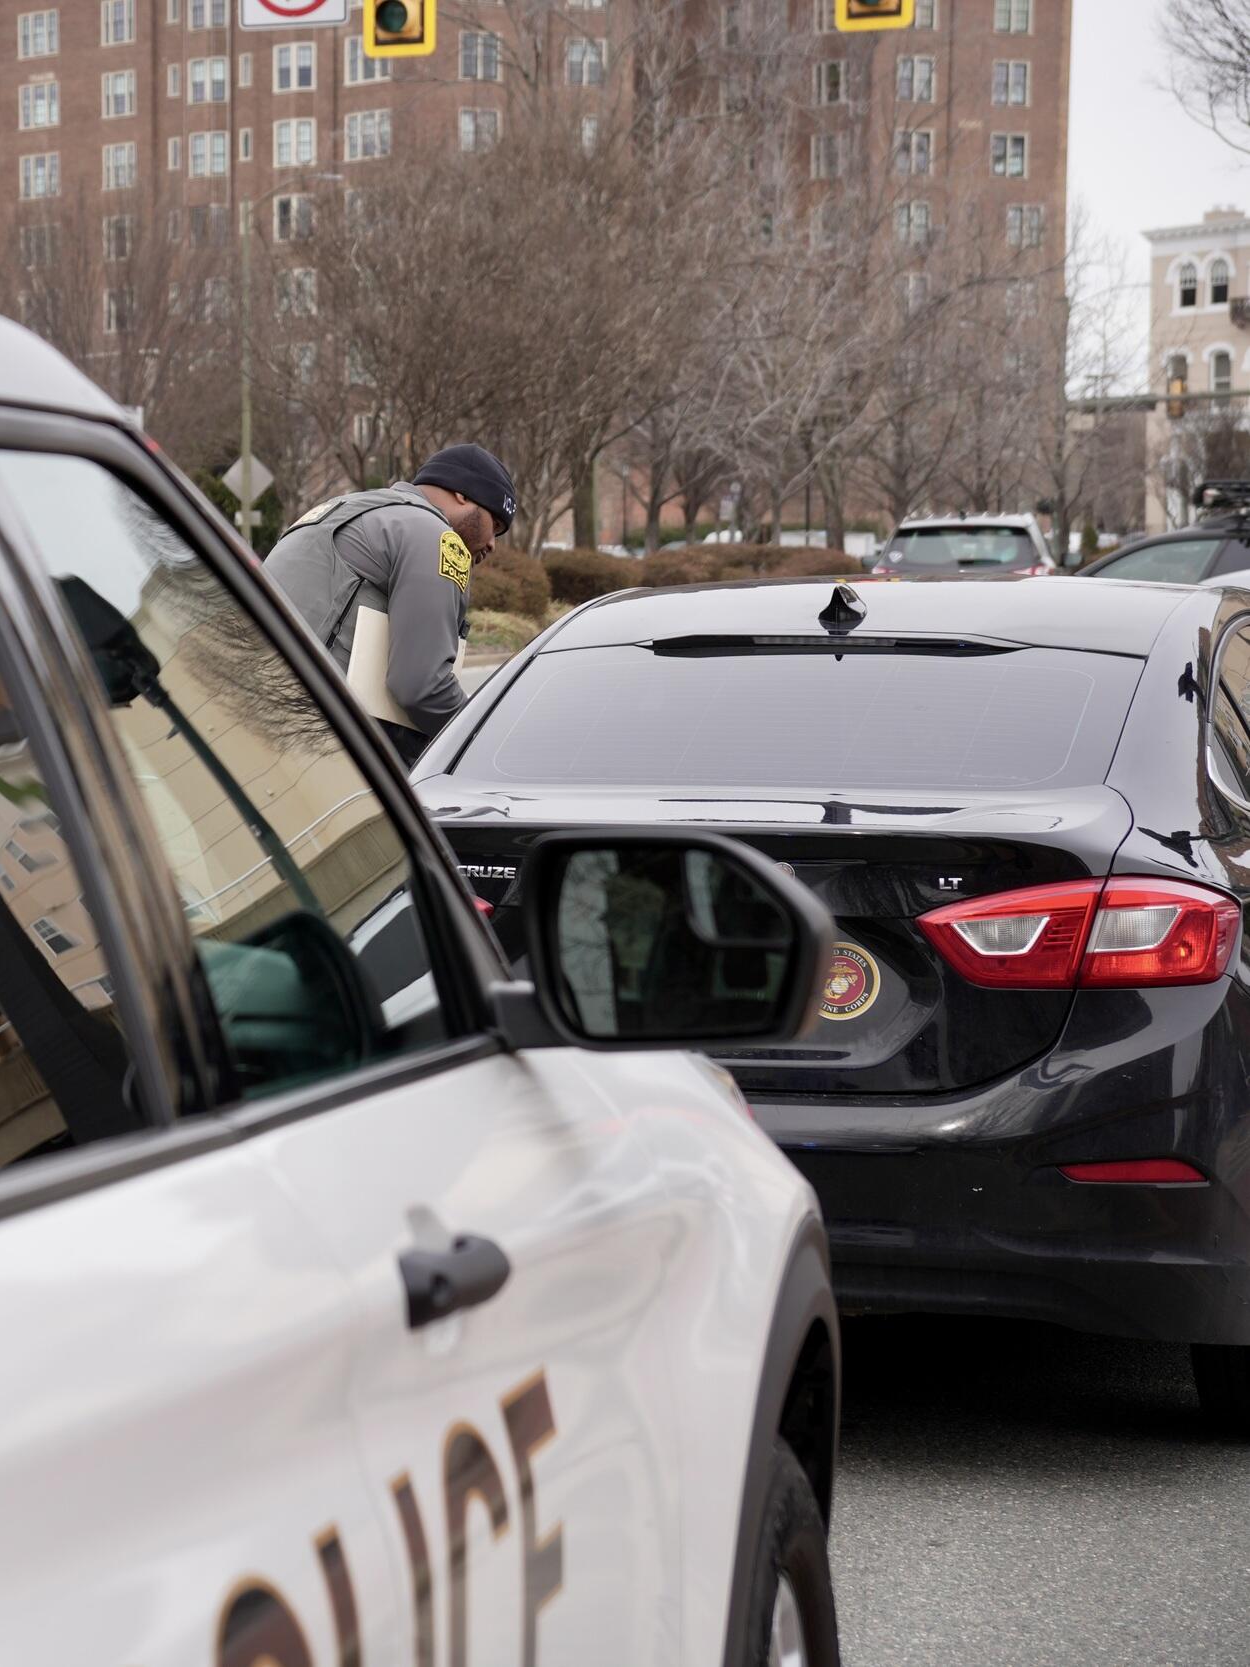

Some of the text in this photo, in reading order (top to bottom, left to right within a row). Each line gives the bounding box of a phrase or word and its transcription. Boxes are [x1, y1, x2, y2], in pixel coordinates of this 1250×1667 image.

[443, 564, 467, 587] POLICE
[456, 864, 517, 879] CRUZE
[939, 877, 963, 890] LT
[843, 949, 868, 968] STATES
[845, 992, 869, 1012] CORPS
